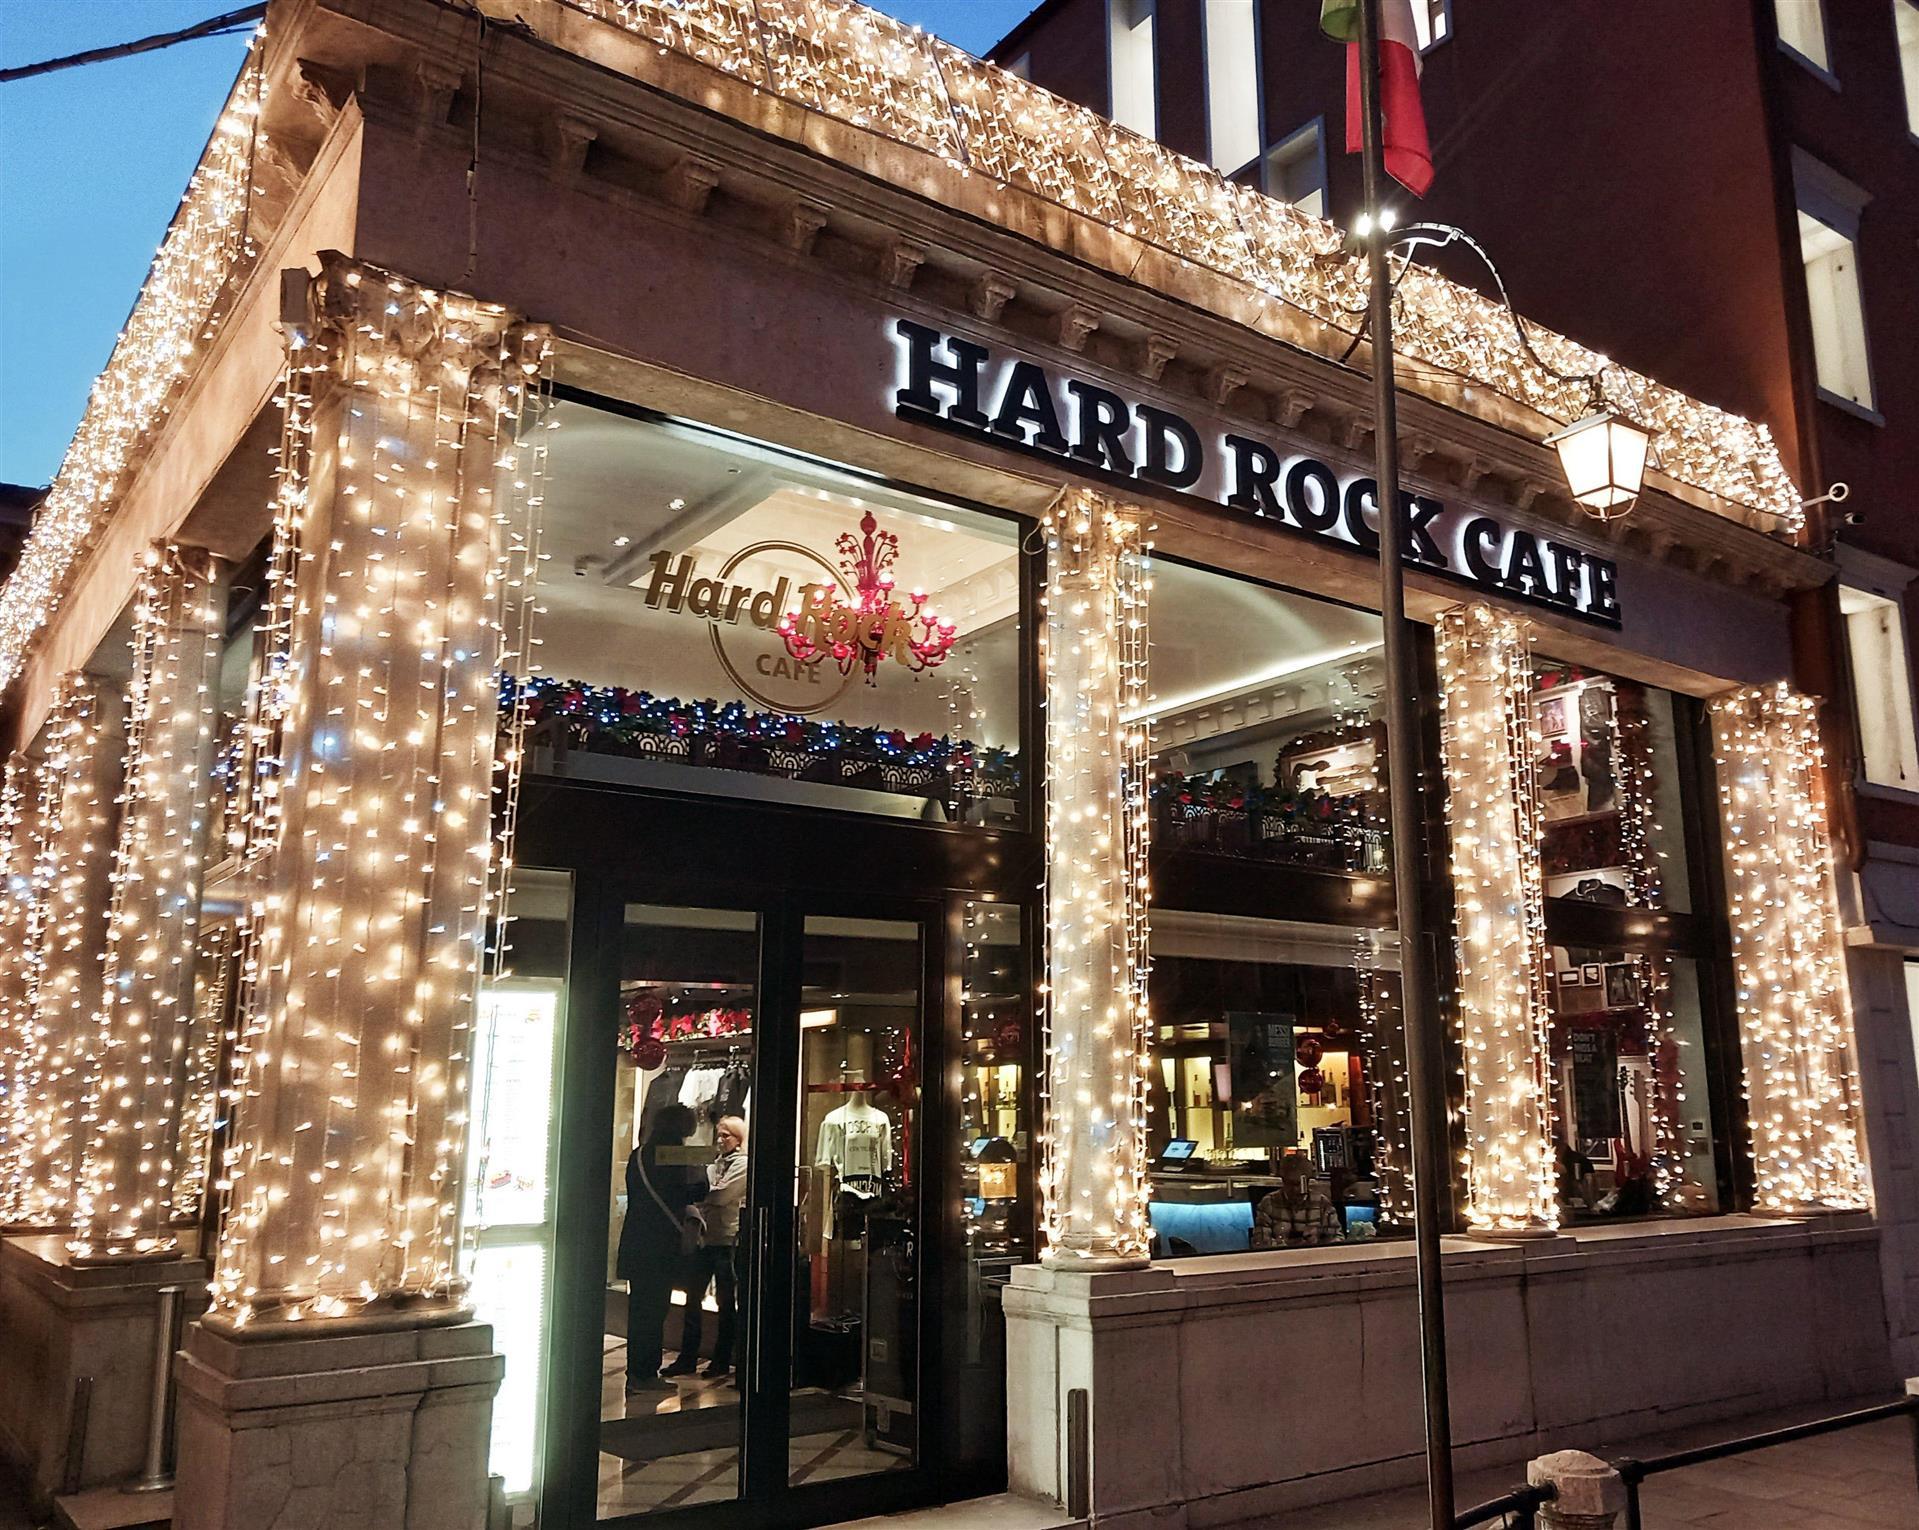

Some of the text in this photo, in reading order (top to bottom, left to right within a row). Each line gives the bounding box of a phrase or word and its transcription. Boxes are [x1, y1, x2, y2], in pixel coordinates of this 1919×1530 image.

[896, 319, 1623, 614] HARD ROCK CAFE
[644, 550, 912, 665] Hard Rock
[756, 653, 821, 684] CAFE
